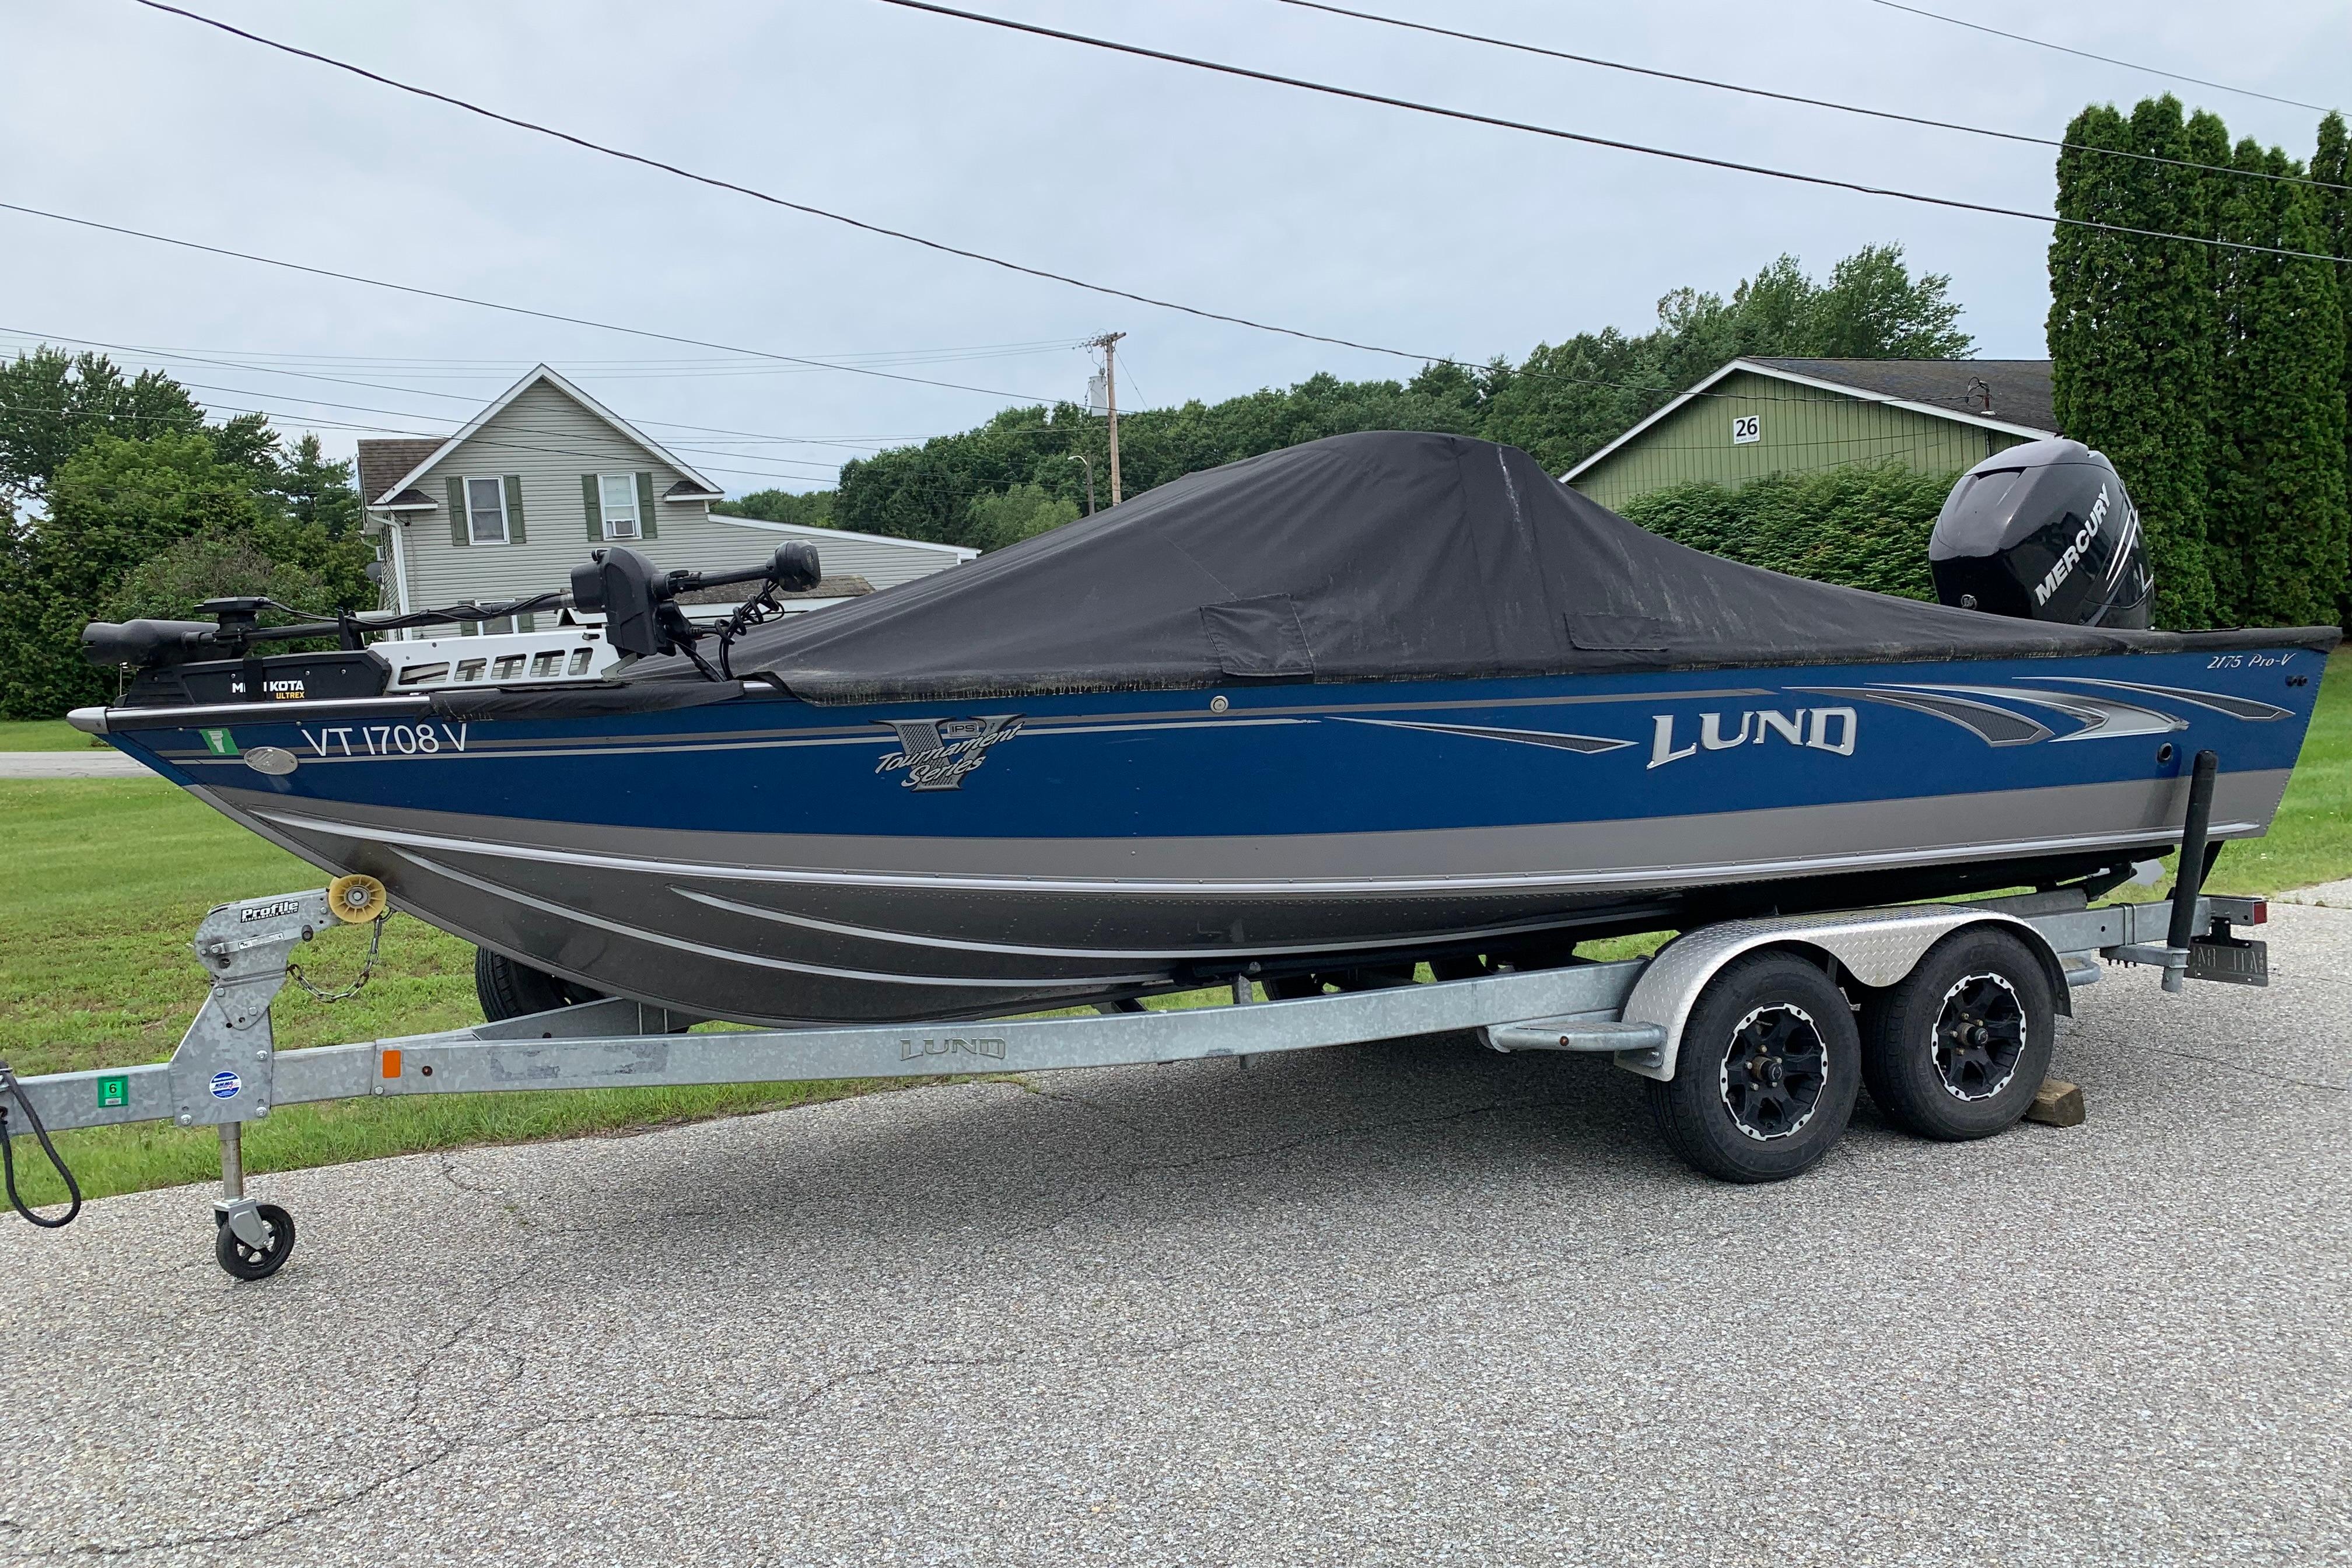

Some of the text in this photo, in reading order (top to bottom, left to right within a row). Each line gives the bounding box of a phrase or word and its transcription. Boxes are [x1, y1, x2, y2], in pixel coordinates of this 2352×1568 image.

[1736, 417, 1758, 437] 26
[2035, 482, 2110, 607] MERCURY
[2207, 653, 2297, 669] 2175 Pro-V
[270, 680, 304, 692] KOTA
[276, 691, 304, 699] ULTREX
[301, 723, 467, 757] VT 1708 V
[874, 721, 1025, 774] Tournament
[1646, 706, 1858, 770] LUND
[901, 755, 987, 788] Series
[242, 901, 299, 919] Profile
[900, 1038, 1006, 1061] LUND
[108, 1083, 117, 1094] 6
